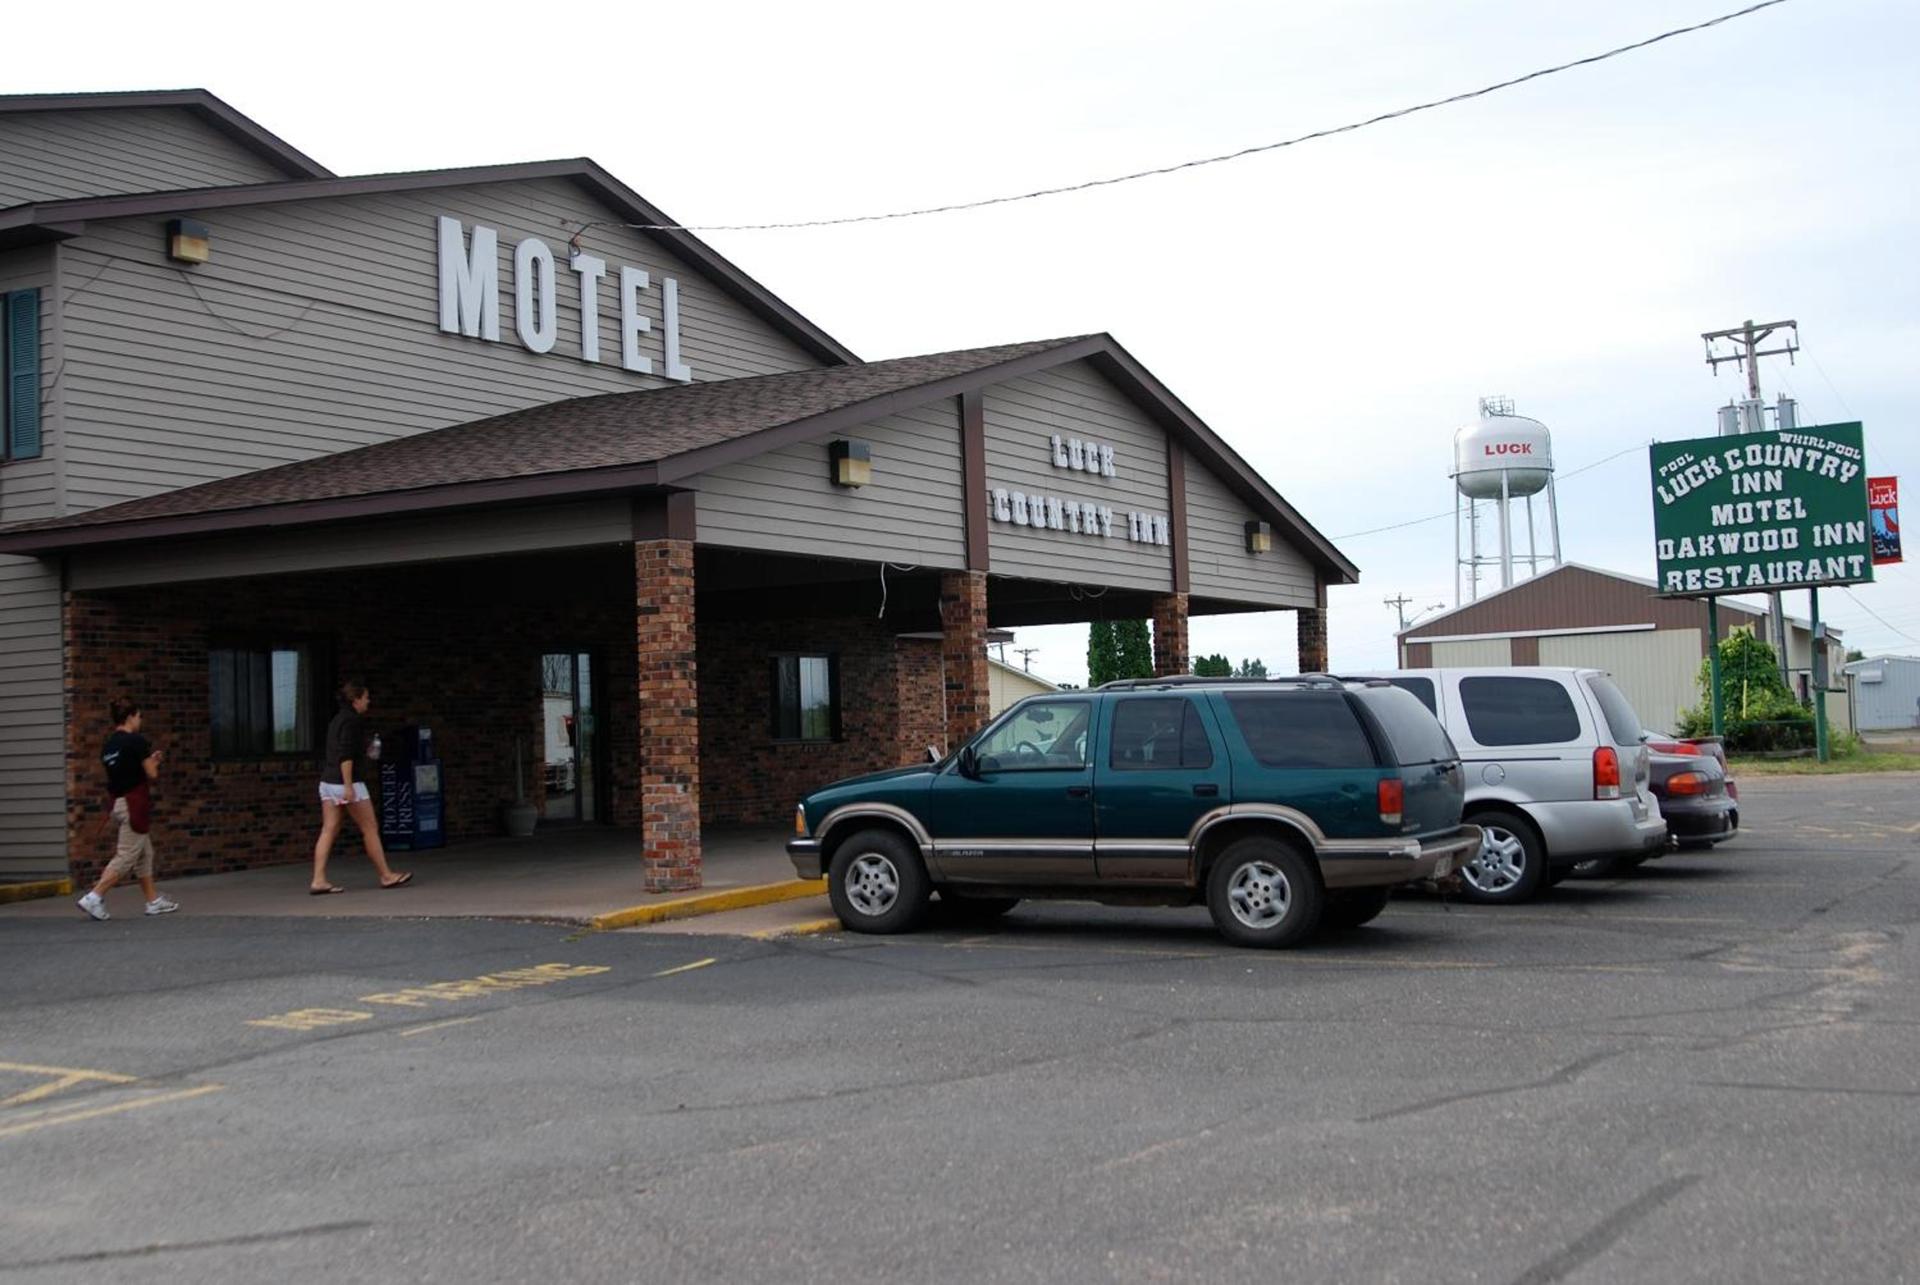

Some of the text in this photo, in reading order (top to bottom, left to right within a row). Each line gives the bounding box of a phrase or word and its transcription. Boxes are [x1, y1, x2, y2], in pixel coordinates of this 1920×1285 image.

[437, 215, 692, 383] MOTEL
[1051, 433, 1116, 477] LUCK
[1484, 443, 1532, 456] LUCK
[1659, 452, 1695, 477] POOL
[1779, 432, 1862, 460] WHIRLPOOL
[1657, 444, 1860, 505] LUCK COUNTRY
[1731, 470, 1783, 495] INN
[1711, 497, 1807, 527] MOTEL
[1870, 488, 1897, 505] Luck
[992, 487, 1170, 546] COUNTRY INN
[1657, 520, 1866, 560] OAKWOOD INN
[1666, 555, 1865, 592] RESTAURANT
[382, 763, 398, 834] PIONEER
[398, 781, 414, 834] PRESS
